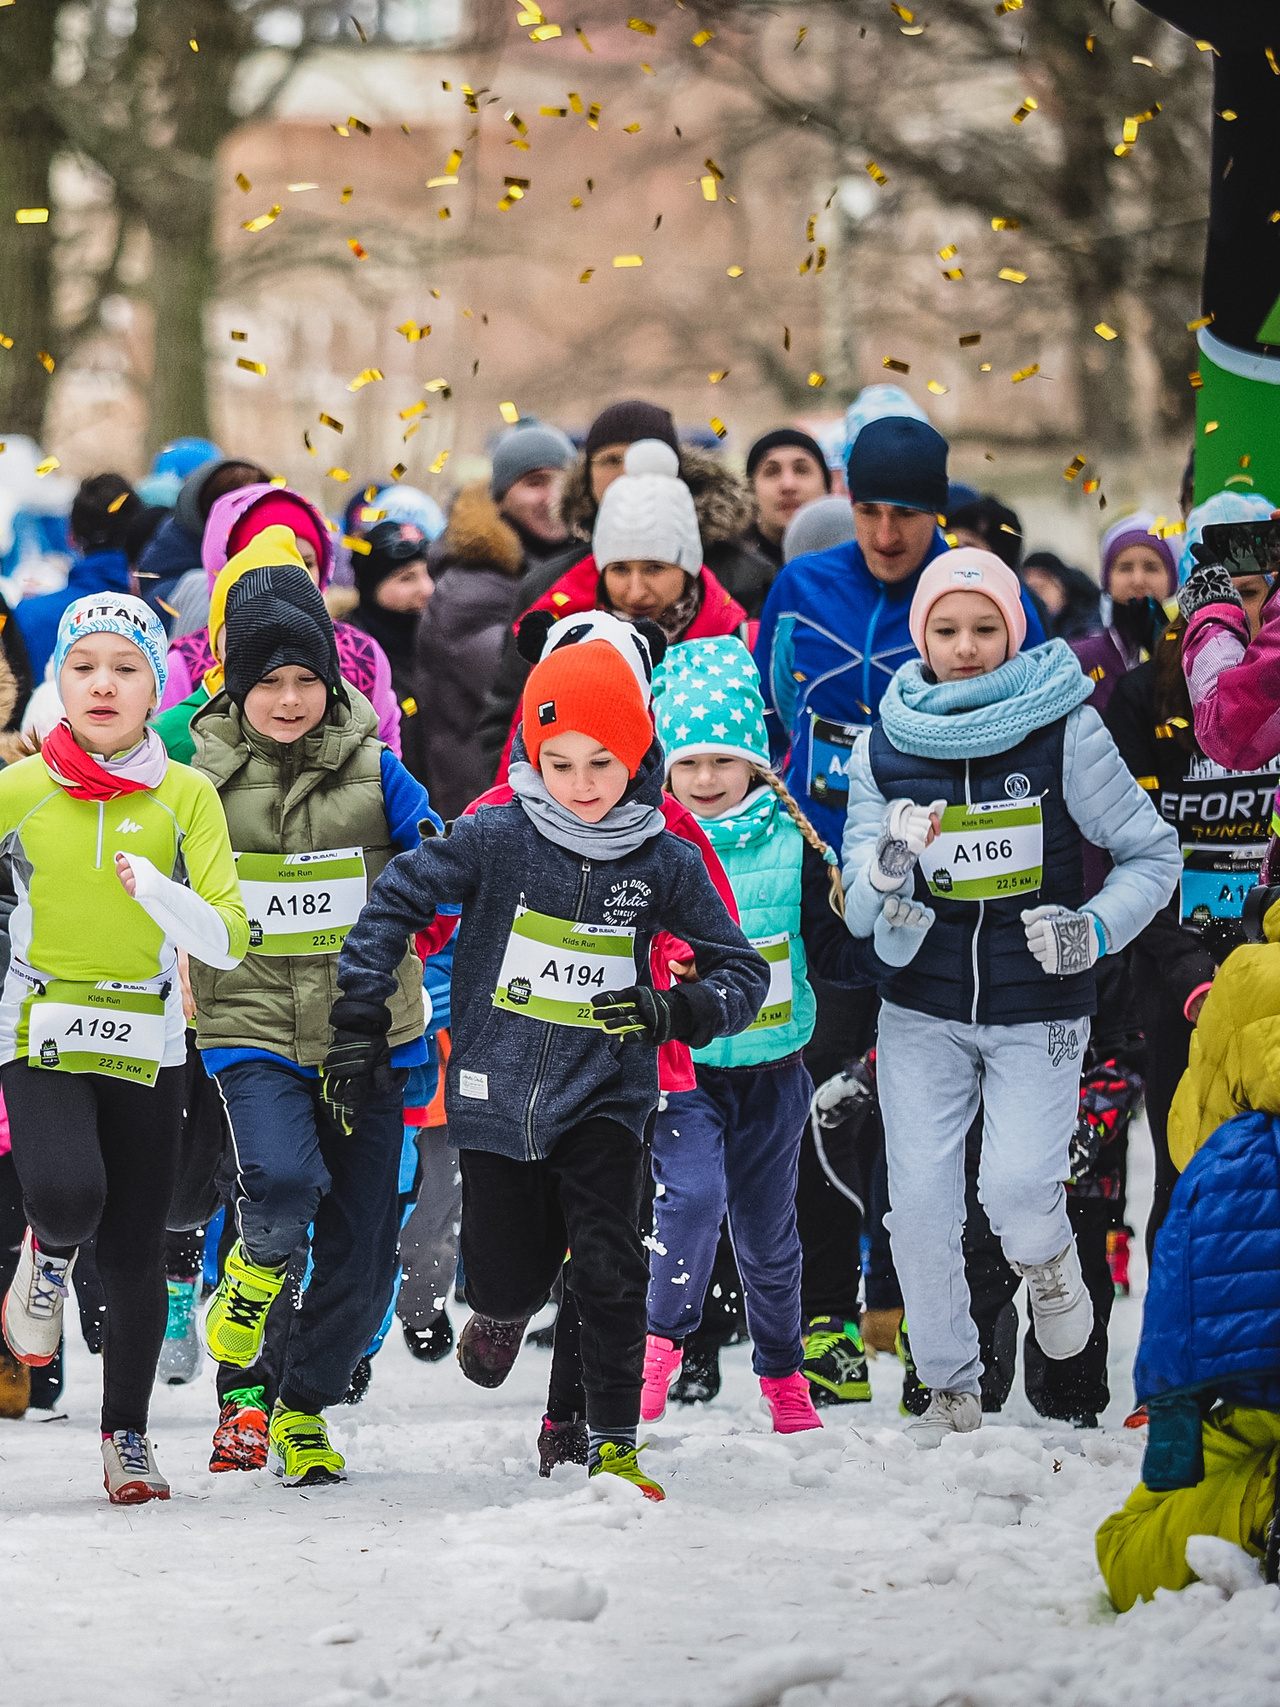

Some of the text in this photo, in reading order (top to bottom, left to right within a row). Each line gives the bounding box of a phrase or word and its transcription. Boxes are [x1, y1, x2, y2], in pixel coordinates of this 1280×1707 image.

[73, 606, 147, 633] TITAN
[953, 839, 1013, 864] A166
[611, 879, 652, 897] OLD DOCKS
[996, 878, 1017, 889] 22,5
[266, 892, 332, 916] A182
[604, 890, 649, 907] Arctic
[603, 911, 618, 926] SHIP
[312, 934, 336, 946] 22,5
[562, 937, 596, 948] Kids Run
[540, 960, 605, 987] A194
[87, 995, 104, 1003] Kids
[577, 1008, 591, 1019] 22
[65, 1018, 132, 1043] A192
[99, 1058, 124, 1070] 22,5
